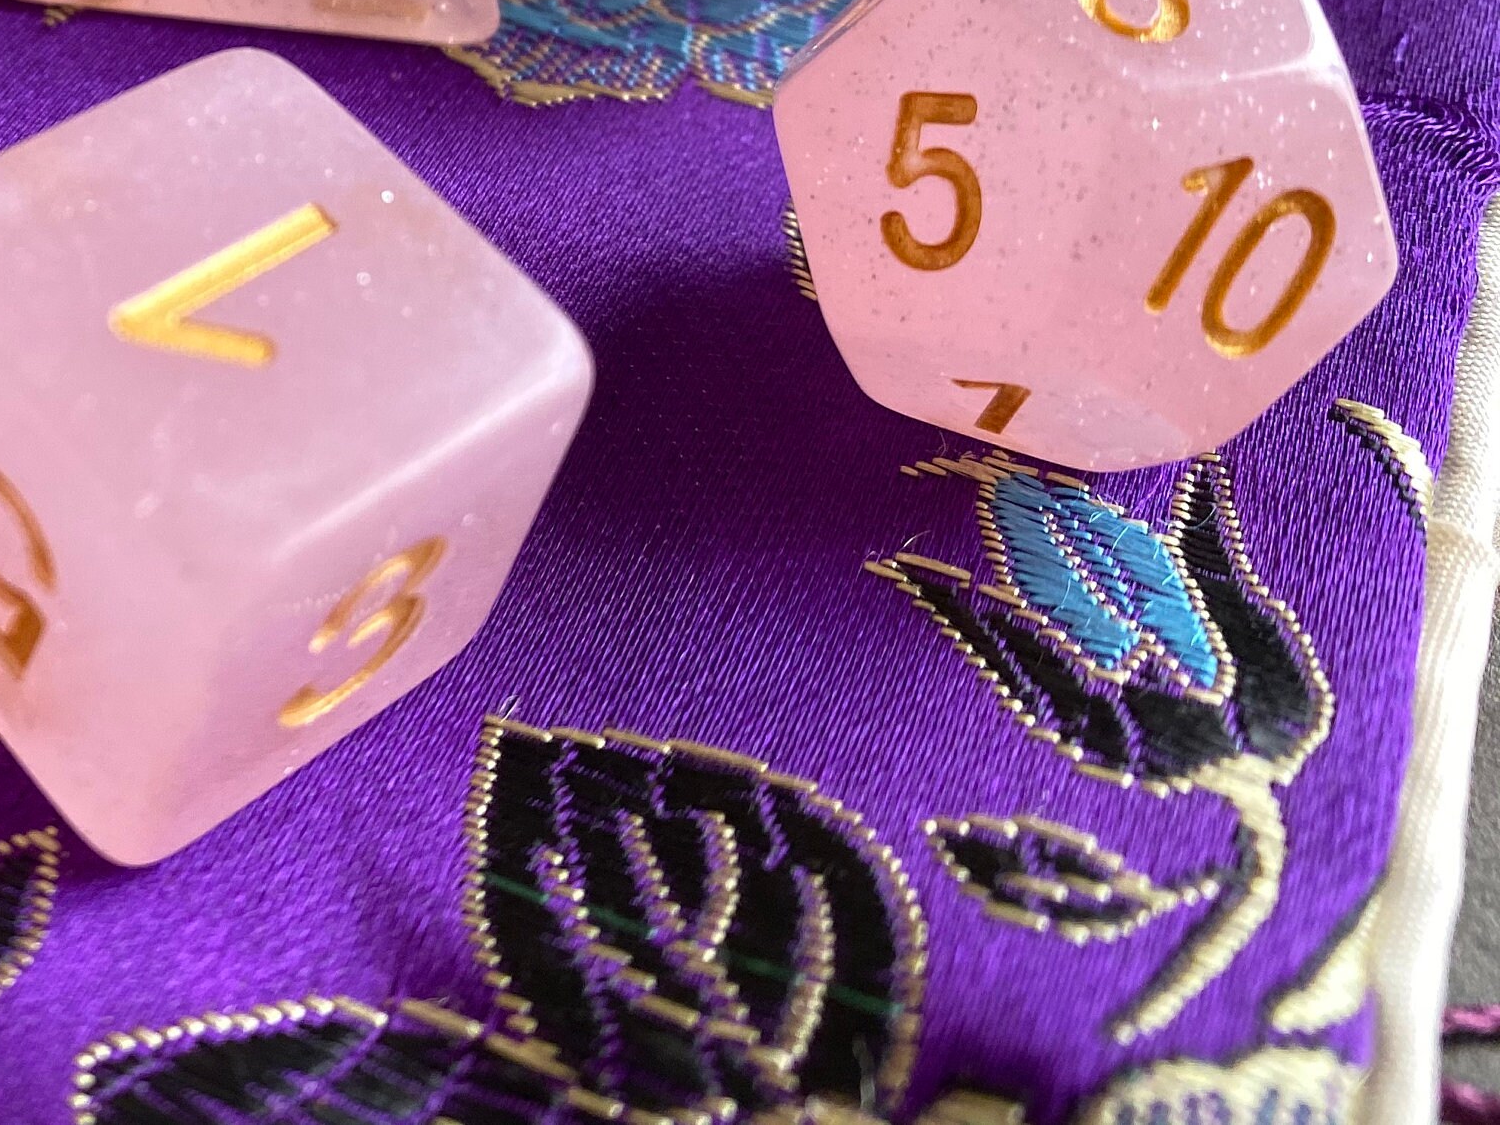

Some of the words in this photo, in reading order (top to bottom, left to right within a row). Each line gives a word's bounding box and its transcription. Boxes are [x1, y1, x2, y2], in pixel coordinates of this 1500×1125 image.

[879, 90, 982, 272] 5
[1143, 155, 1336, 361] 10
[277, 533, 449, 728] 3
